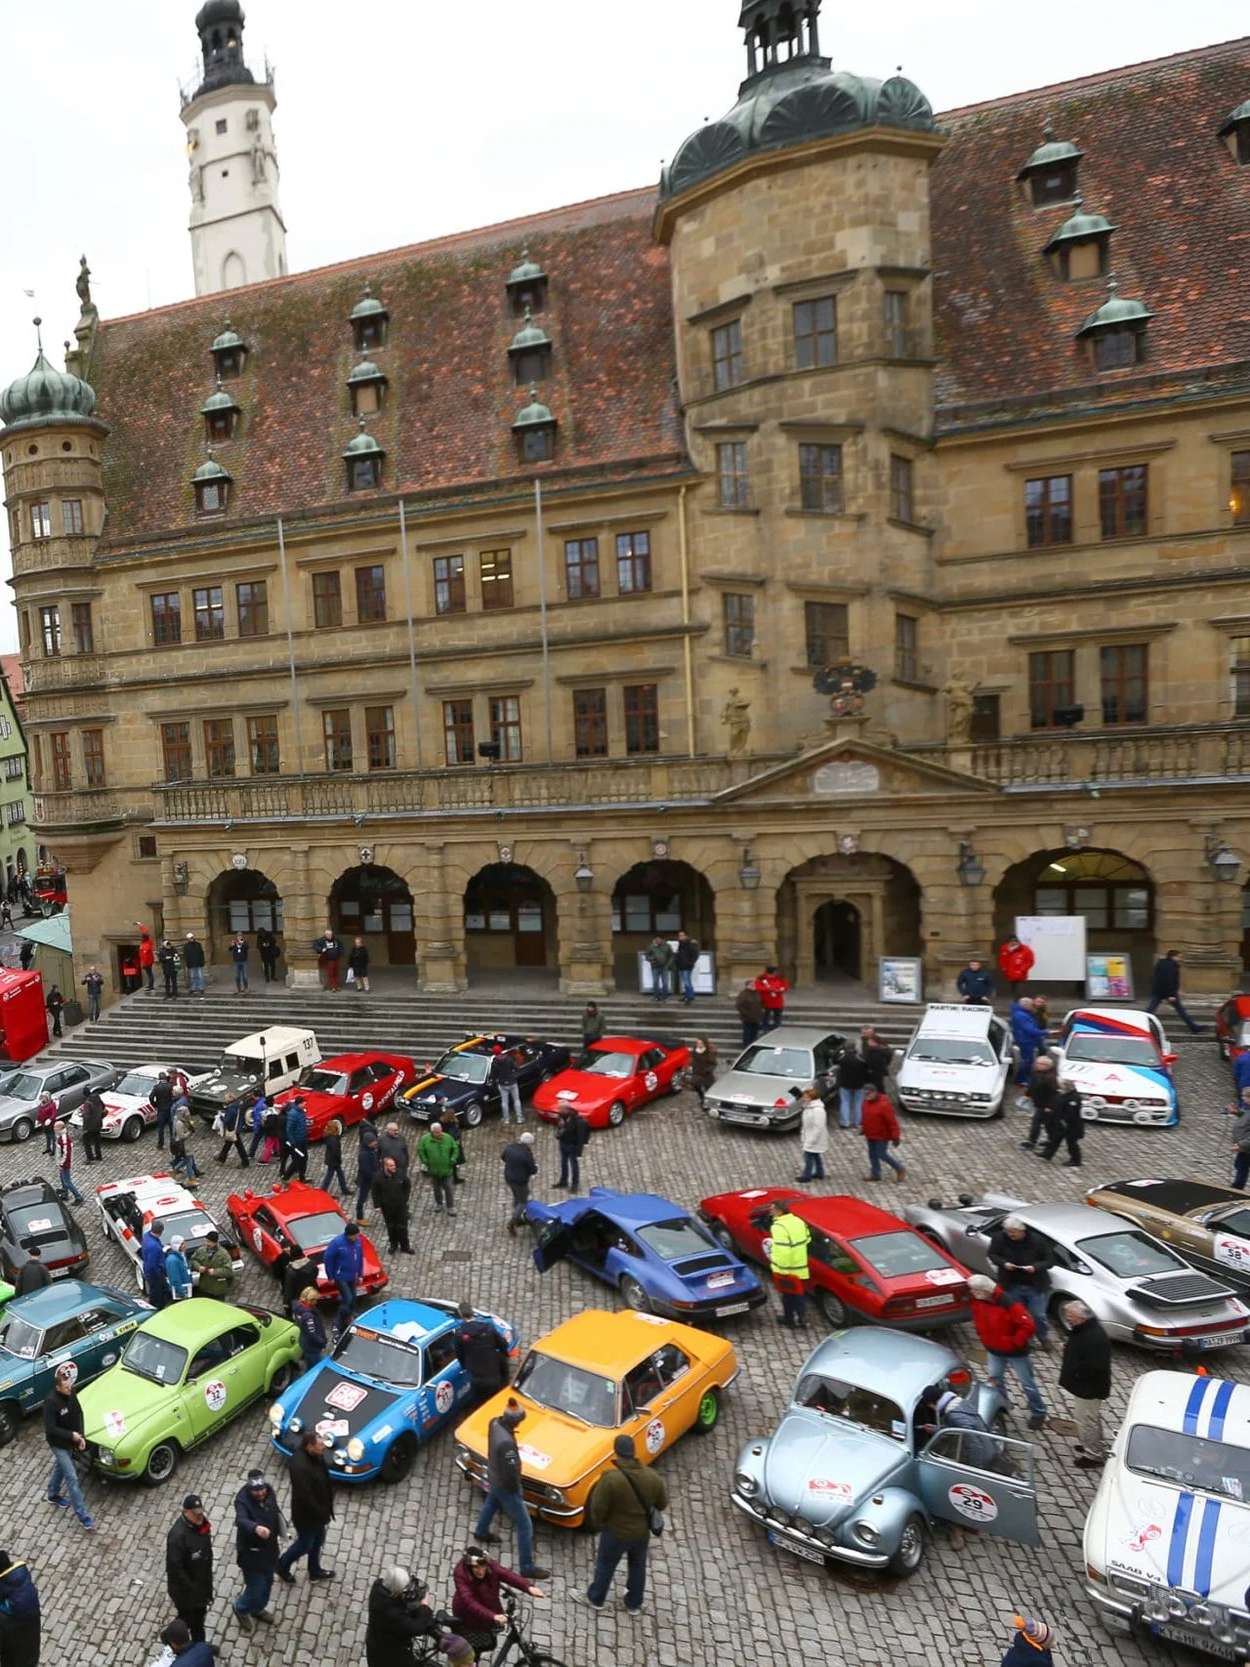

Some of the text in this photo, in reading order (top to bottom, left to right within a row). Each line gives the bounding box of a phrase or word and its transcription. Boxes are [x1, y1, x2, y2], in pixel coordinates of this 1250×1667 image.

[302, 1037, 313, 1050] 137
[1227, 1248, 1242, 1260] 58
[211, 1389, 220, 1401] 32
[962, 1495, 983, 1510] 29
[1111, 1560, 1161, 1582] SAAB V4
